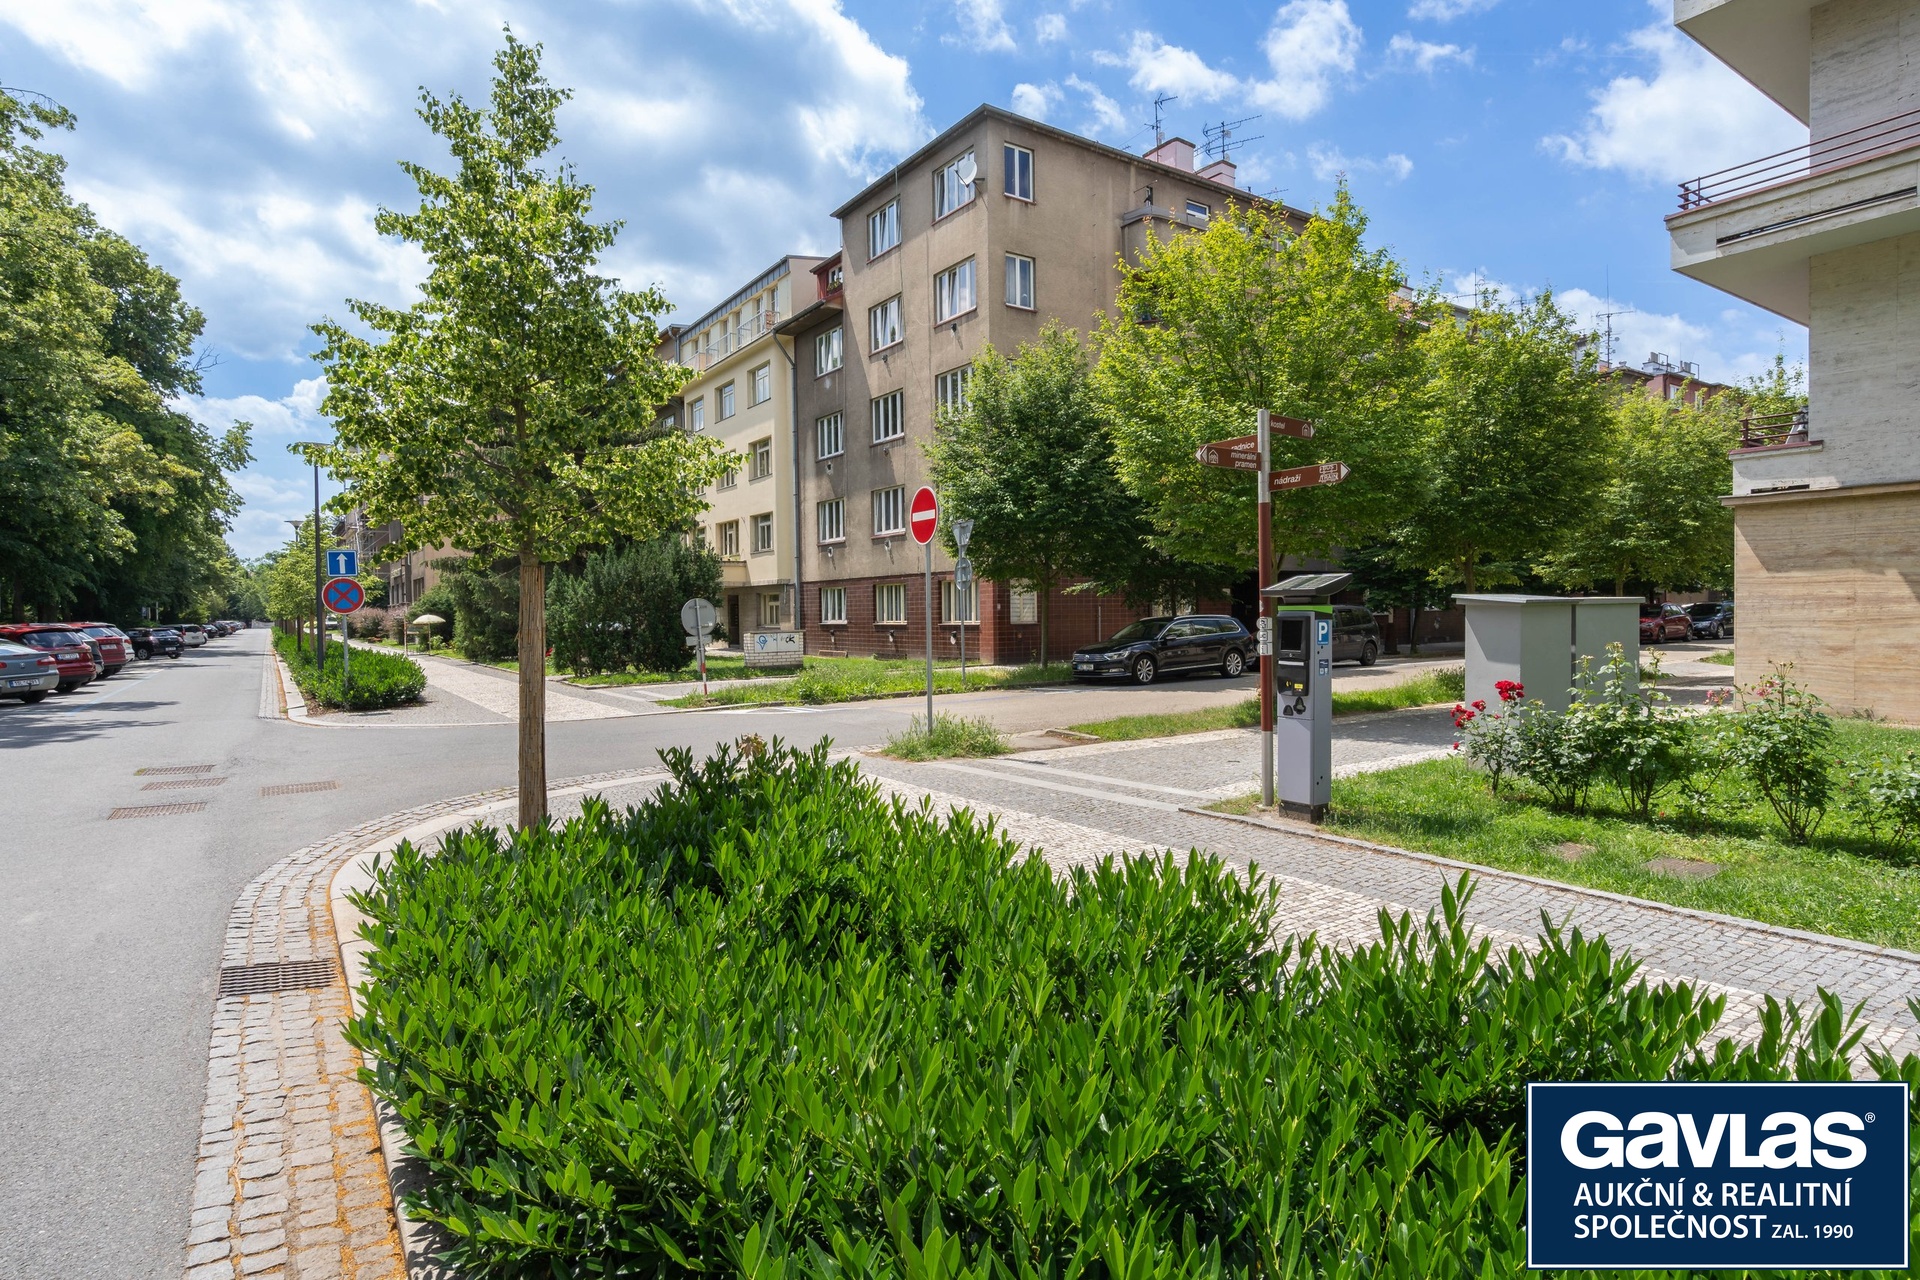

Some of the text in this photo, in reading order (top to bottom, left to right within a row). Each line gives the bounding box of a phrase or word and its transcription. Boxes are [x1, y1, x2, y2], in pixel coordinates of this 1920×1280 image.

[1270, 420, 1286, 430] kostel
[1231, 451, 1257, 461] minerální
[1234, 461, 1257, 469] pramen
[1273, 474, 1302, 486] nádraží
[1318, 621, 1328, 641] P
